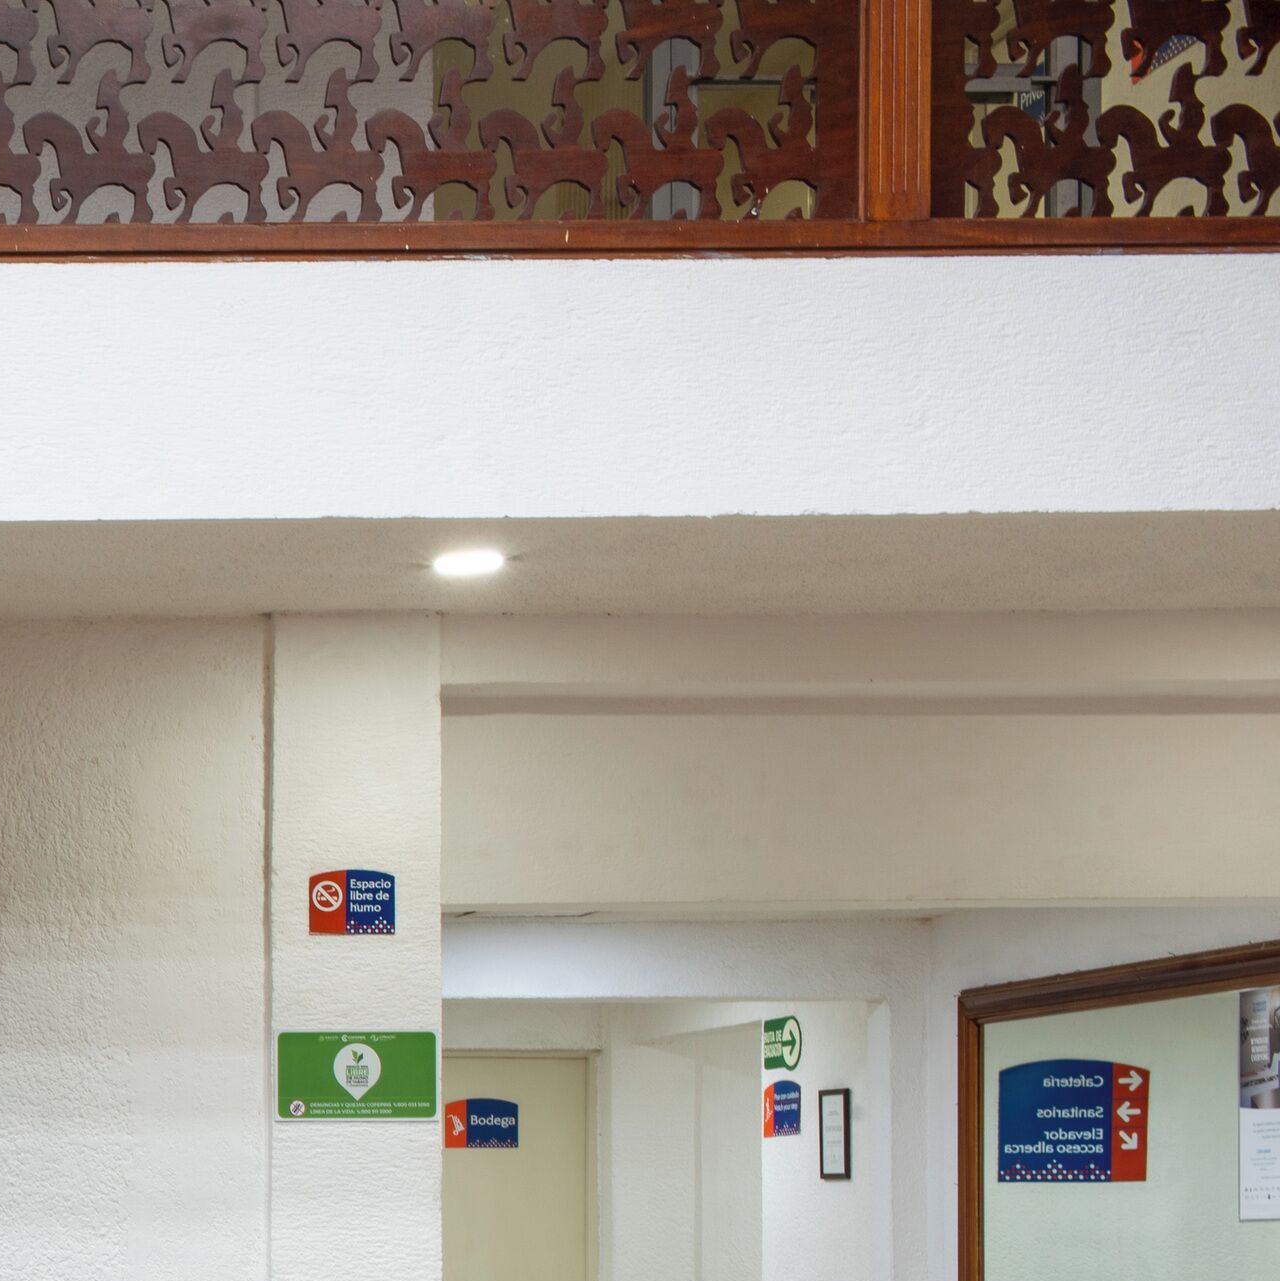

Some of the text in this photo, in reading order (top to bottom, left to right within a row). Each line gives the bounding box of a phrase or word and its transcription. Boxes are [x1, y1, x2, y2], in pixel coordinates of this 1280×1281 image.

[350, 879, 392, 891] Espacio
[350, 890, 390, 901] libre de
[350, 901, 382, 913] humo
[346, 1068, 369, 1077] LIBRE
[470, 1114, 516, 1129] Bodega
